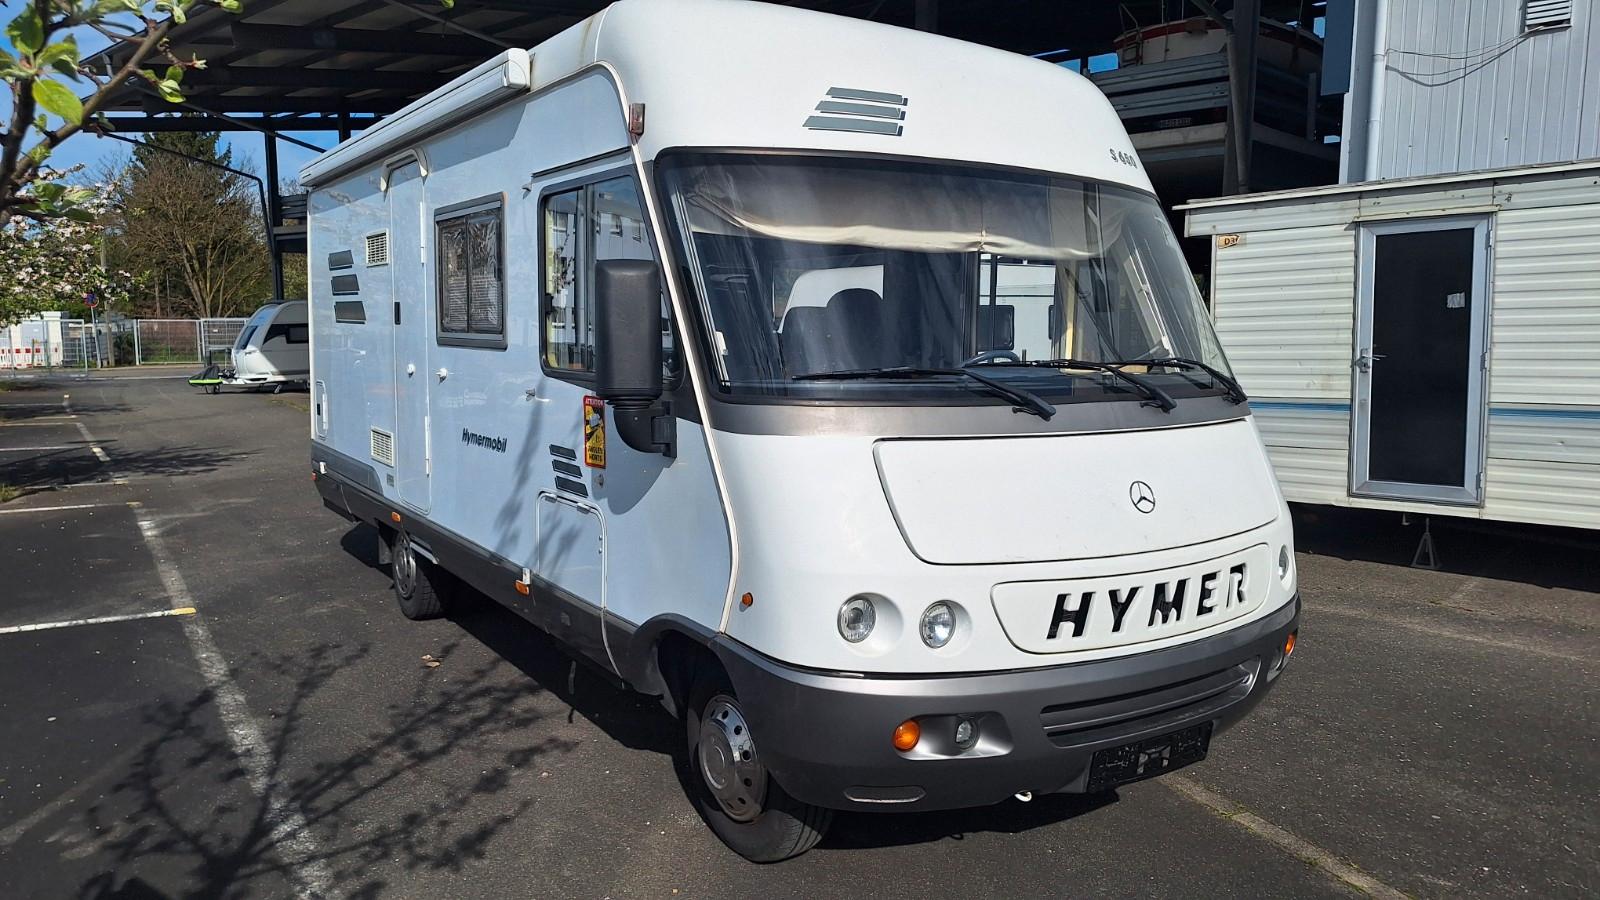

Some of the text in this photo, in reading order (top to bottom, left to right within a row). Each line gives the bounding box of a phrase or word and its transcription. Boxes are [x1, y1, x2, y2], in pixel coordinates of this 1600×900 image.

[1109, 148, 1118, 162] S
[462, 427, 507, 453] Hymermobil
[1046, 562, 1248, 640] HYMER
